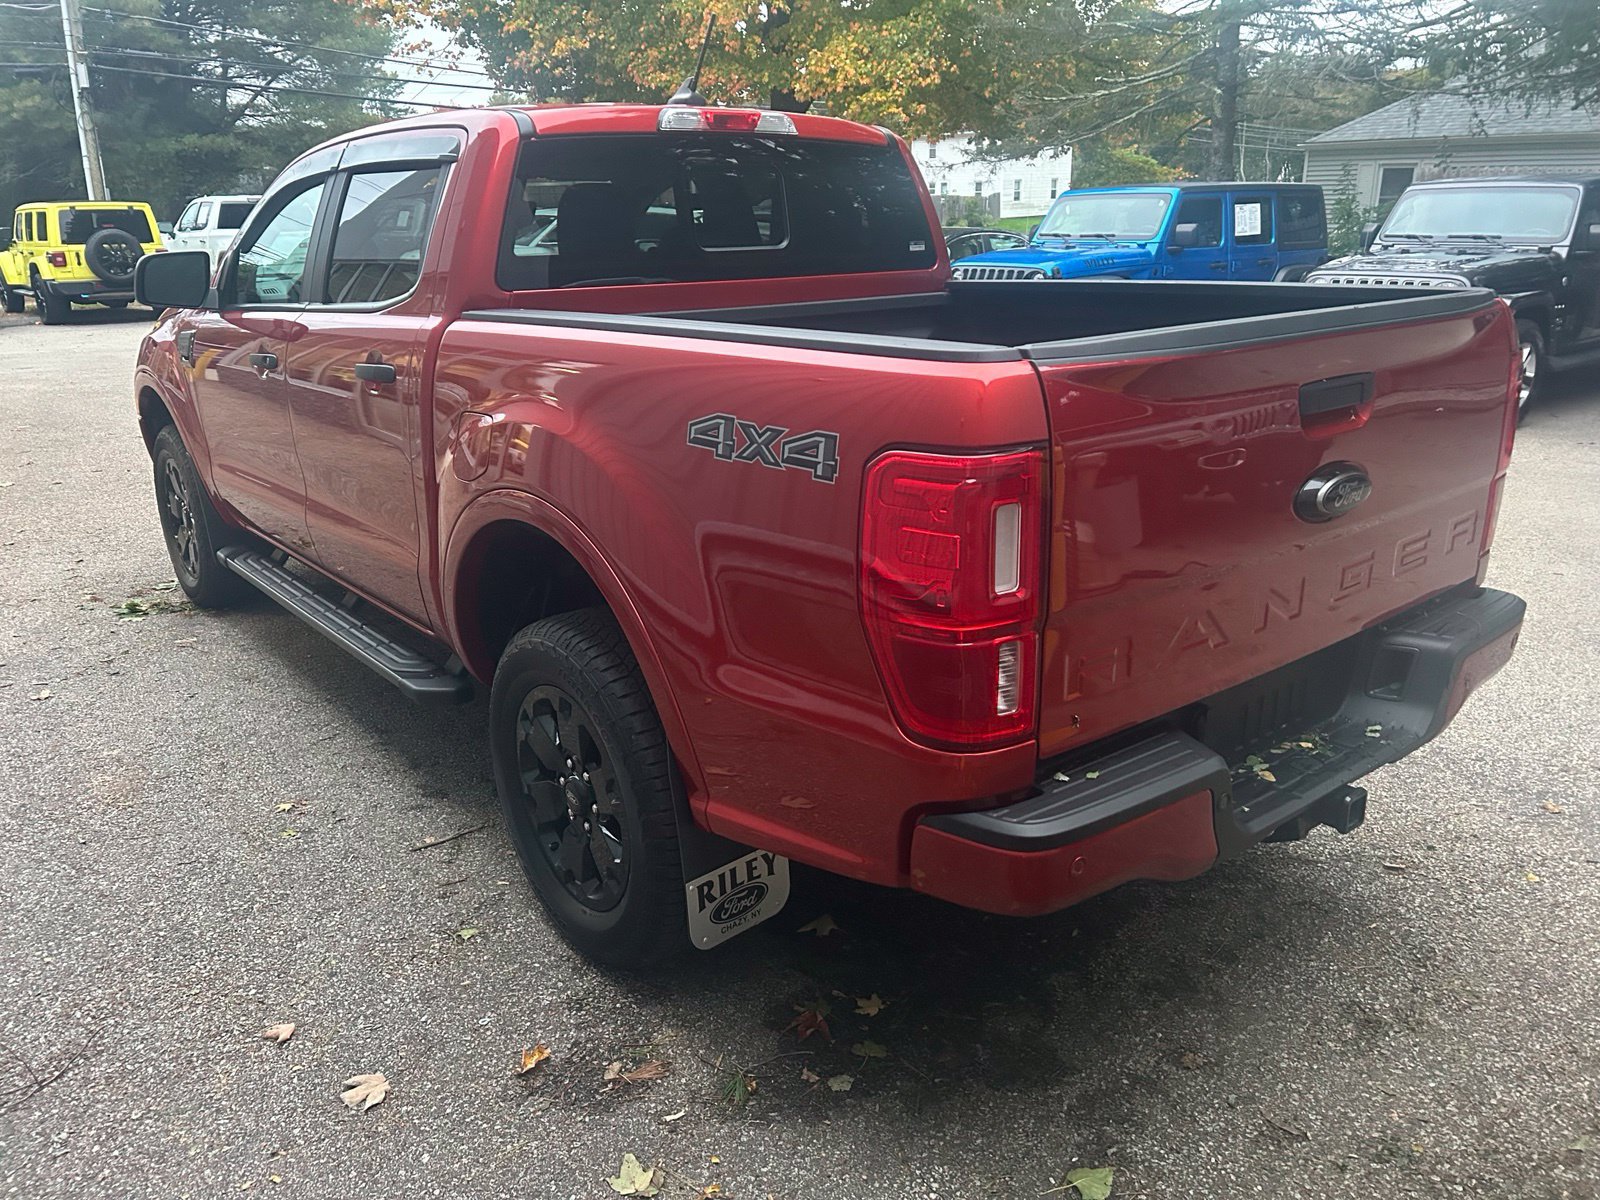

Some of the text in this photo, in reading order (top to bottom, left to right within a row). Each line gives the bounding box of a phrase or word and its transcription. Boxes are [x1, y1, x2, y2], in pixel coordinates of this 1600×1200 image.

[1334, 481, 1364, 507] Ford
[1064, 508, 1478, 700] RANGER
[696, 852, 776, 914] RILEY
[721, 889, 758, 919] Ford
